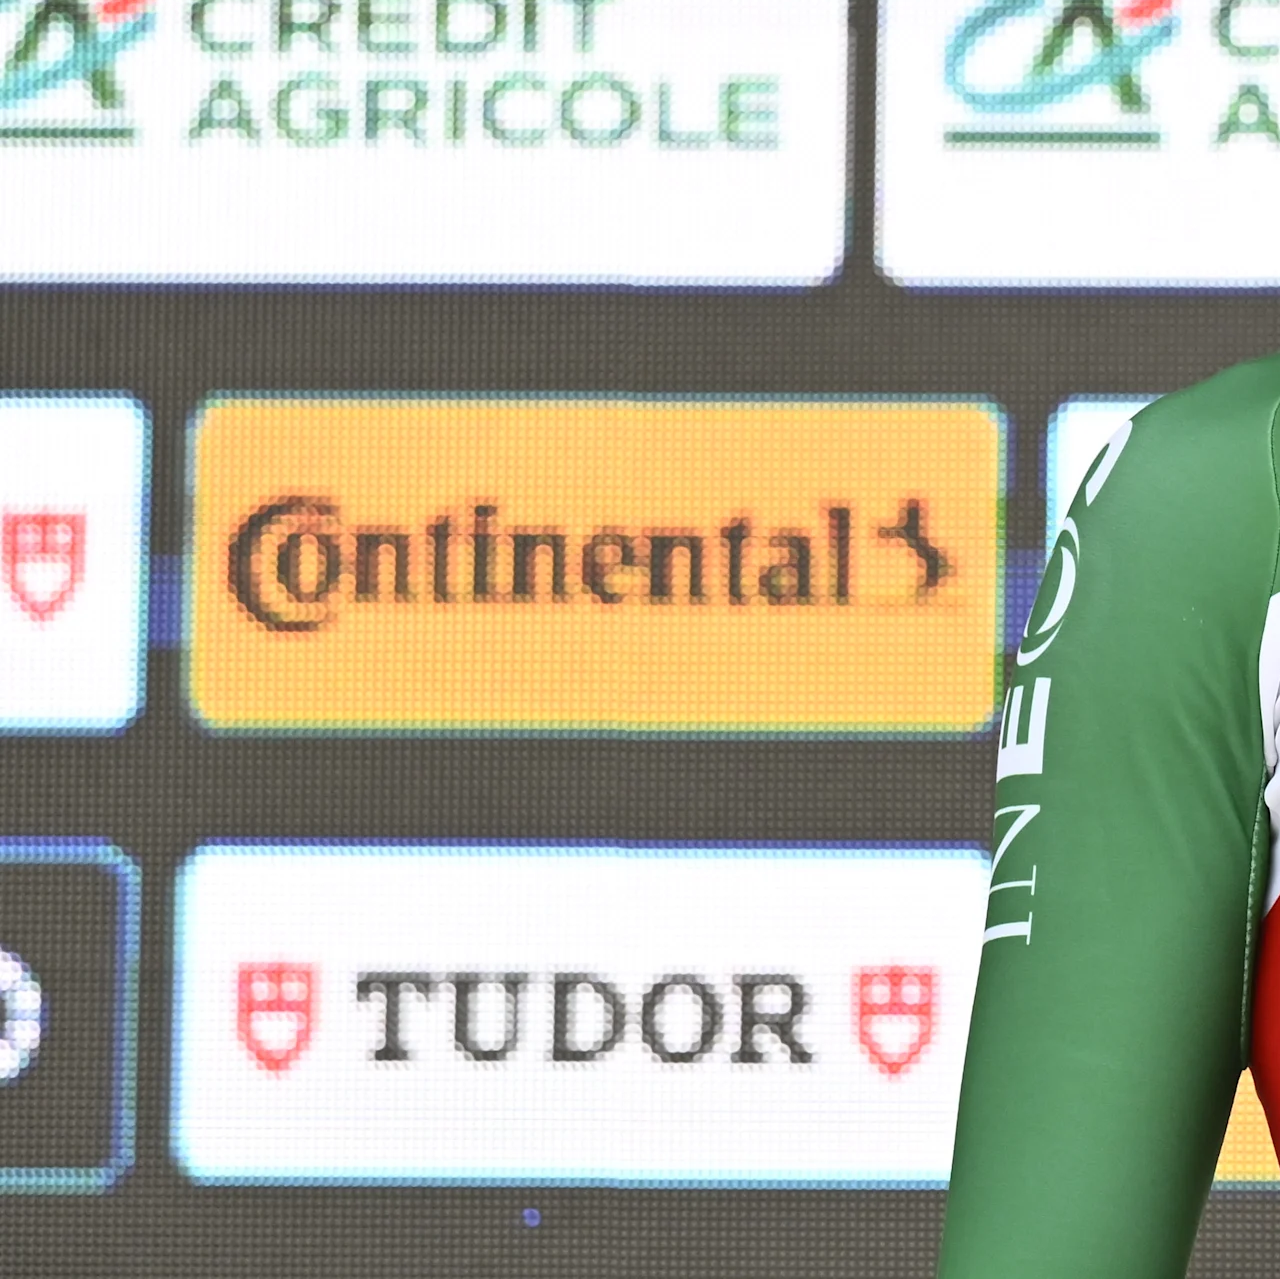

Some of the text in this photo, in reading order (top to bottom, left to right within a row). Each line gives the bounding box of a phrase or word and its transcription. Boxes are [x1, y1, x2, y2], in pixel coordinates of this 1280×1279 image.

[188, 71, 783, 150] AGRICOLE
[228, 495, 853, 633] Continental
[355, 969, 814, 1067] TUDOR
